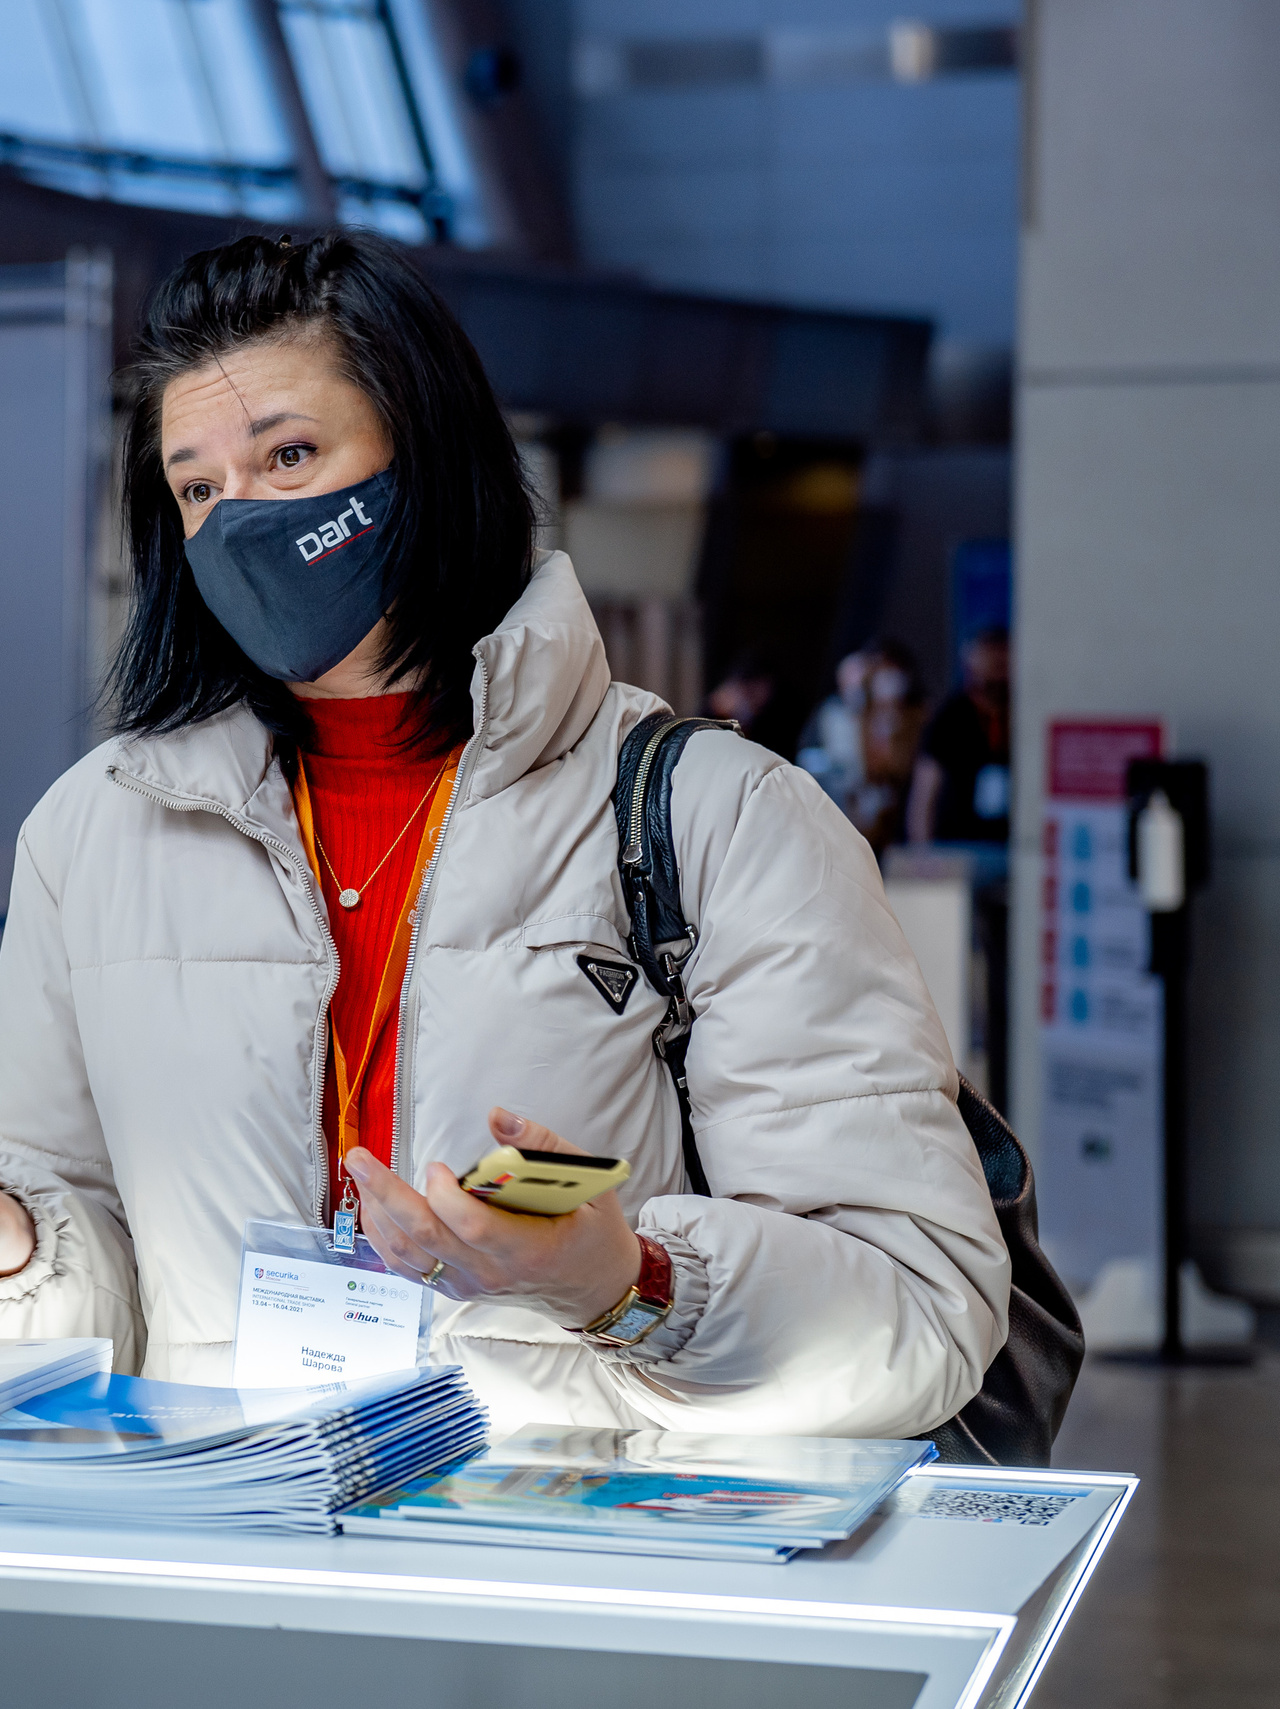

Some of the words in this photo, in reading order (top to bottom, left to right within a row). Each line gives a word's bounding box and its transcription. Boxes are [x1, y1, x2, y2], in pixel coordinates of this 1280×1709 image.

[295, 496, 373, 561] Dart
[266, 1270, 299, 1281] securika
[252, 1287, 298, 1299] МЕЖДУНАРОДНАЯ
[299, 1294, 325, 1303] ВЫСТАВКА
[252, 1294, 286, 1303] INTERNATIONAL
[252, 1299, 268, 1307] 13.04
[272, 1303, 303, 1313] 16.04.2021
[301, 1345, 346, 1362] Надежда
[302, 1357, 343, 1373] Шарова
